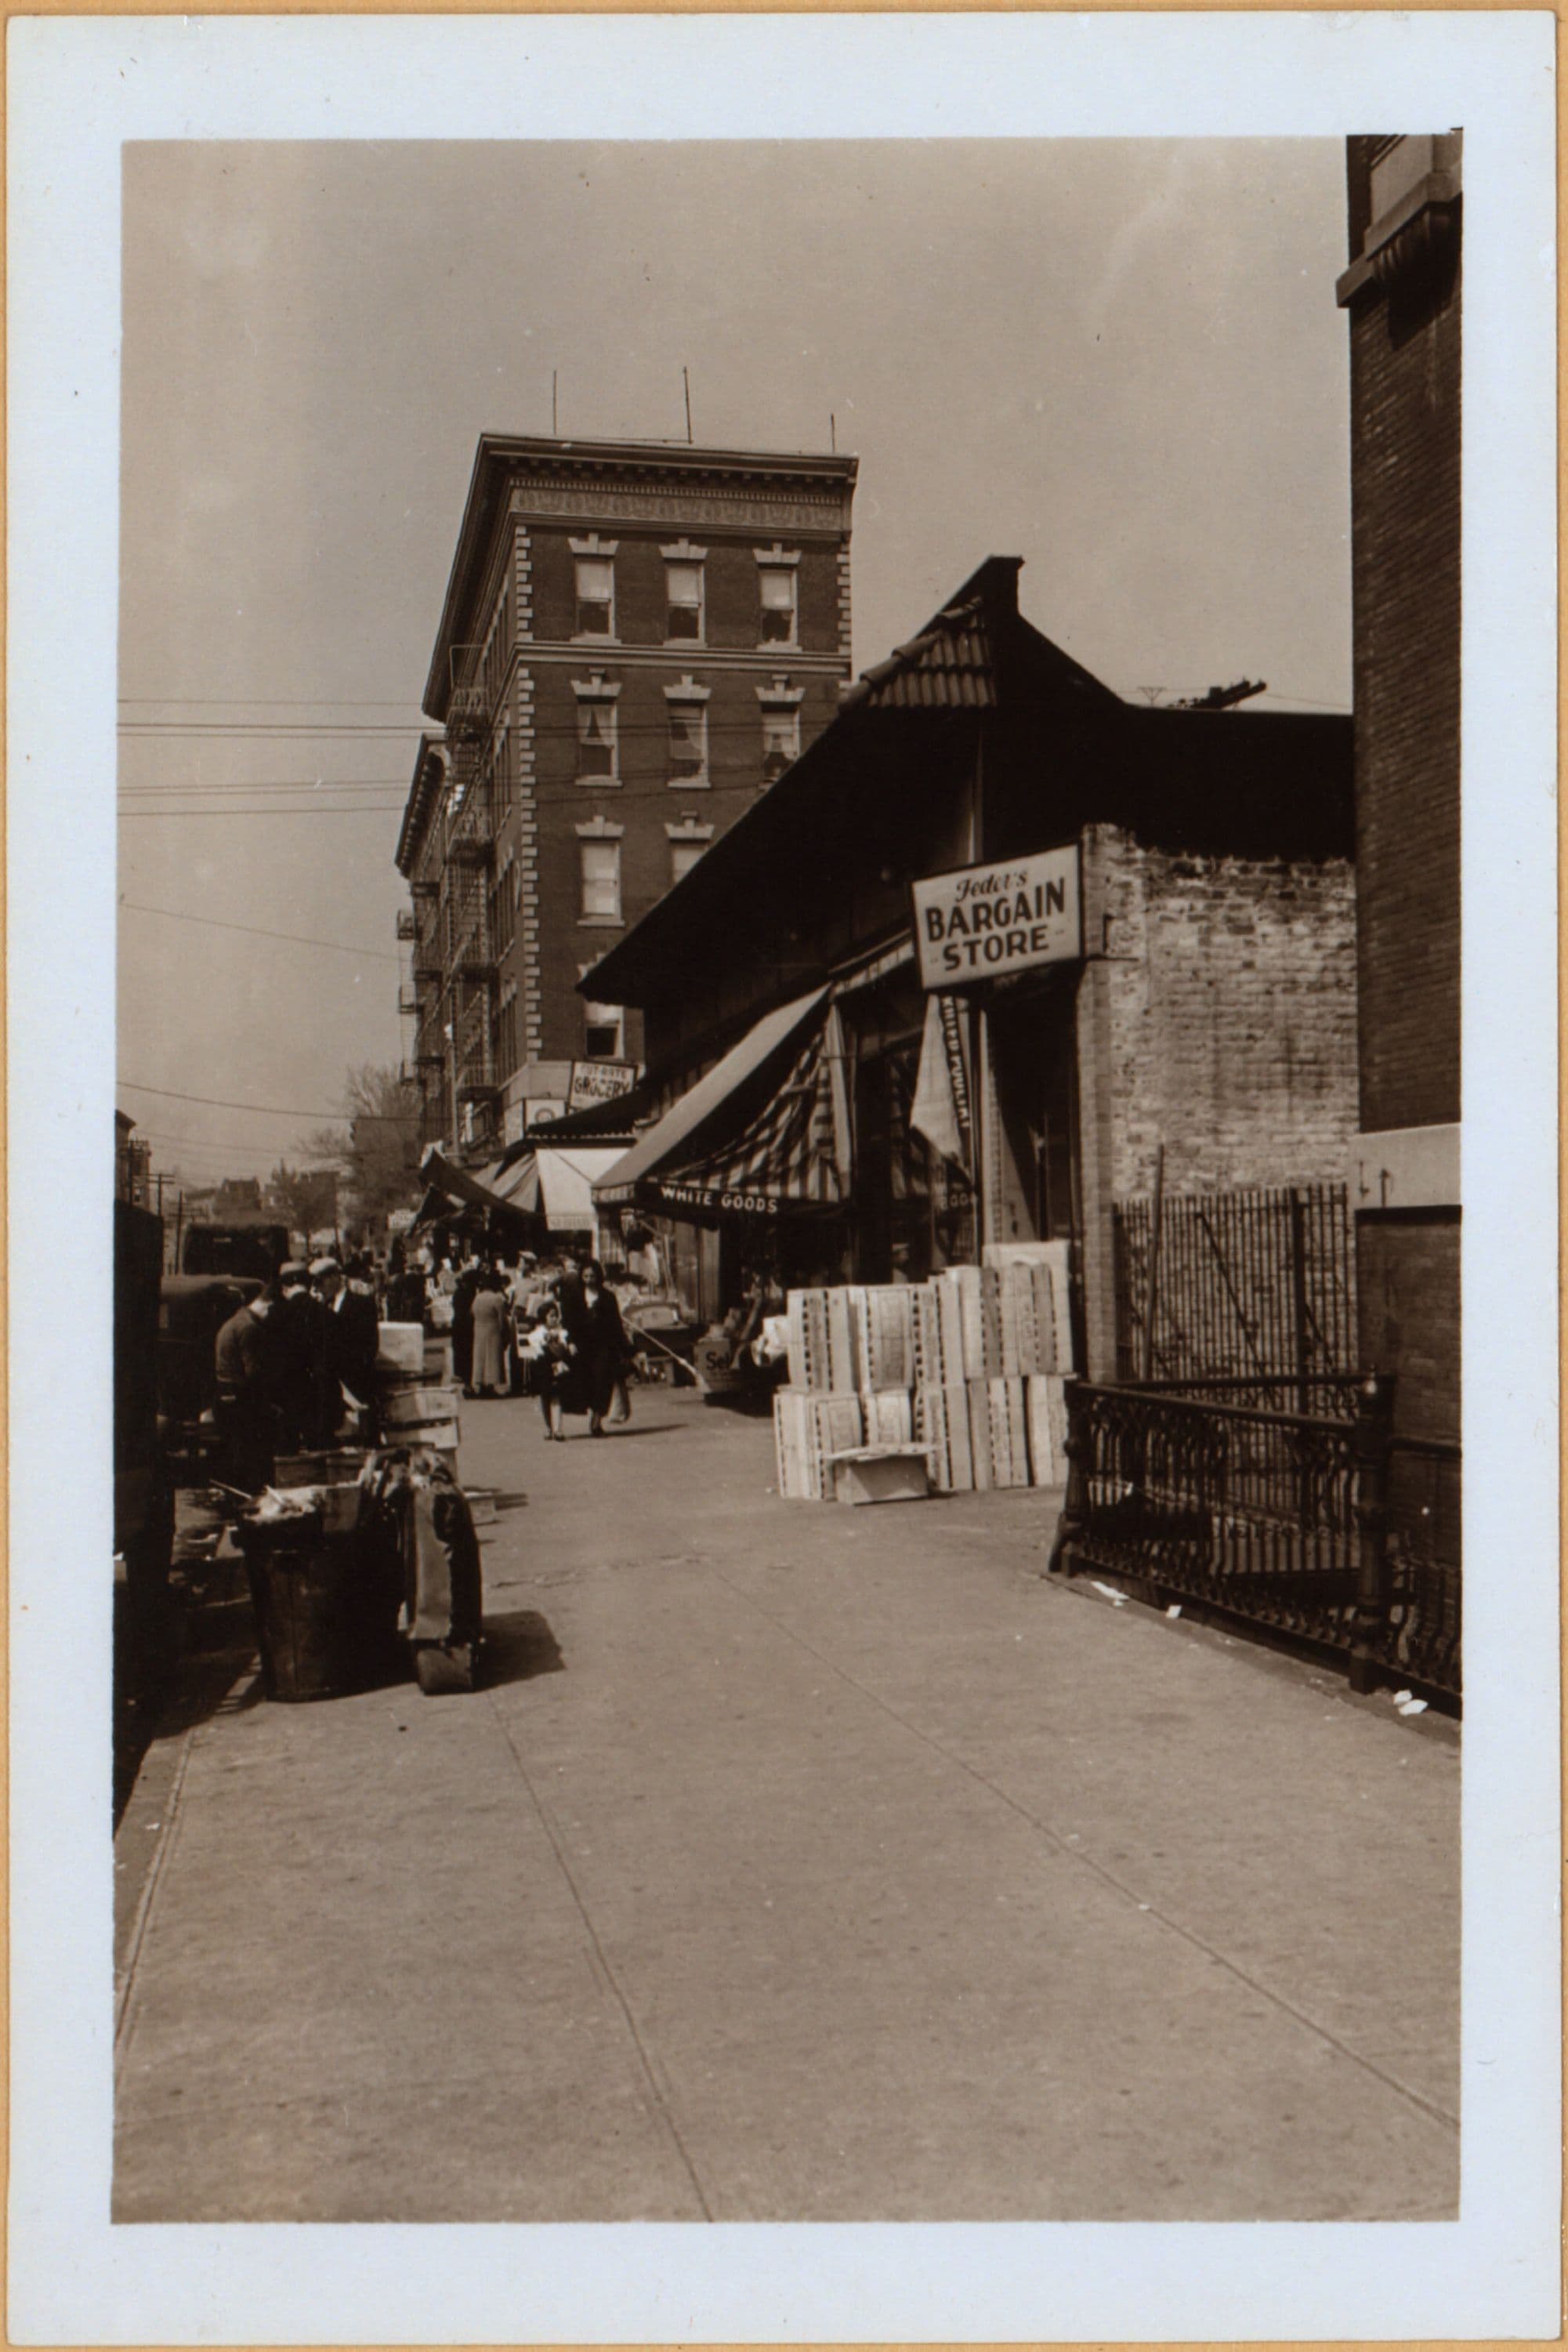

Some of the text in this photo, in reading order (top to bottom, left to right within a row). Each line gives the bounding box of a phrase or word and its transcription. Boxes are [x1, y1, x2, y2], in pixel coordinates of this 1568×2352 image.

[925, 877, 1065, 942] BARGAIN
[943, 924, 1049, 971] STORE
[661, 1187, 777, 1213] WHITE GOODS
